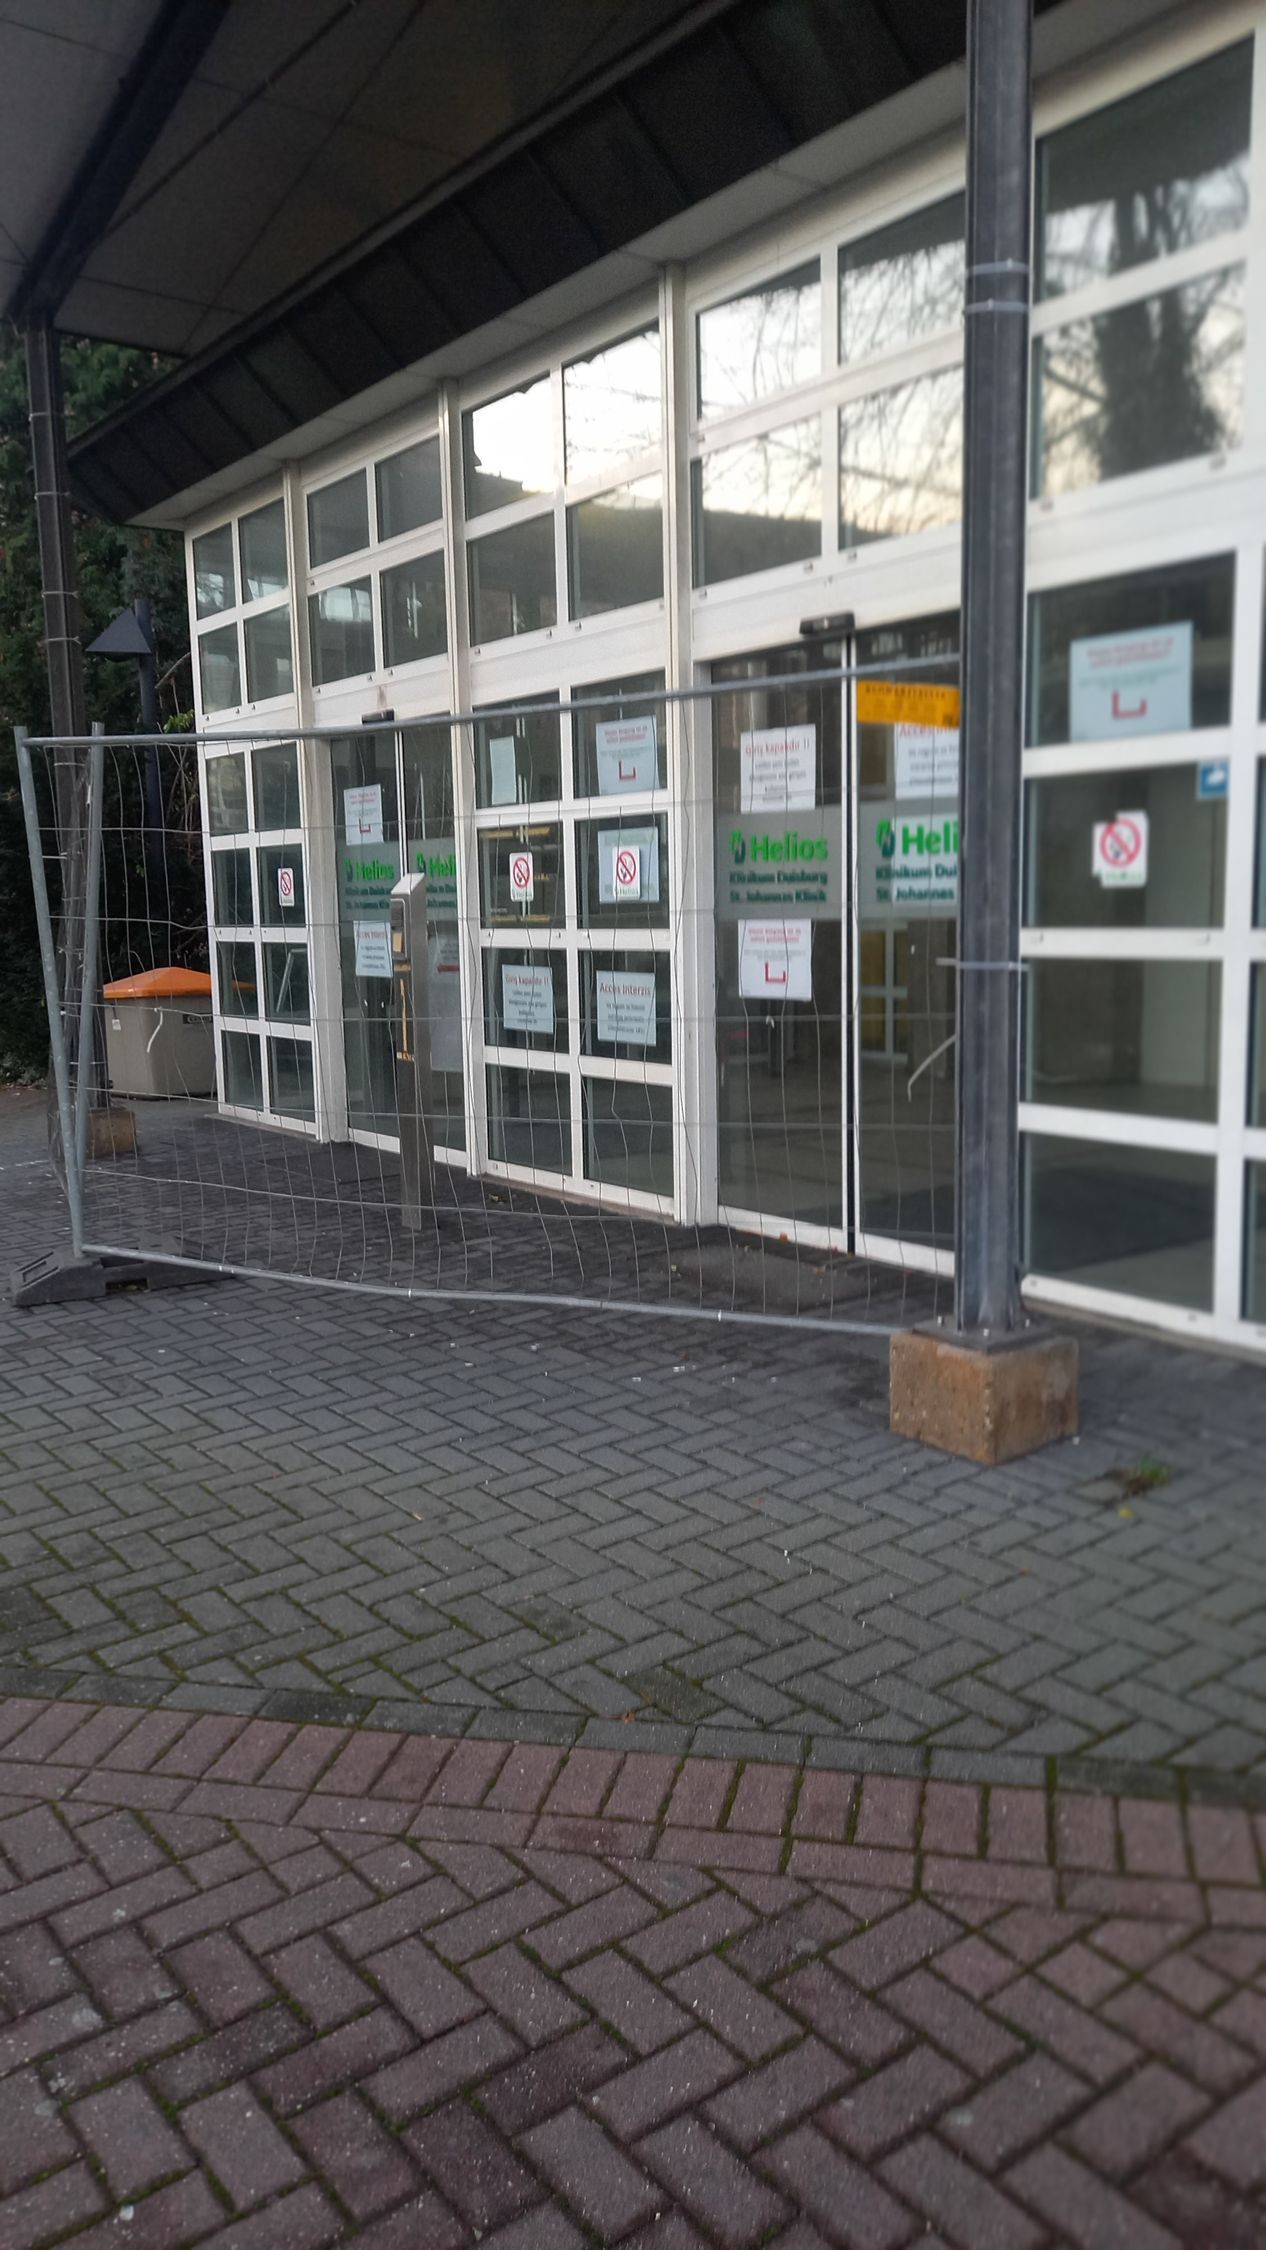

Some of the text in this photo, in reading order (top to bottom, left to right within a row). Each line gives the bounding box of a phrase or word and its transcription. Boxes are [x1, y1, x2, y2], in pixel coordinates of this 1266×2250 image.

[750, 830, 829, 863] Helios
[356, 857, 395, 880] Helios
[729, 868, 828, 886] Klinikum Duisburg
[875, 866, 932, 881] Klinikum
[746, 889, 793, 903] Johannes
[795, 888, 828, 902] Klinik
[896, 885, 955, 901] Johannes
